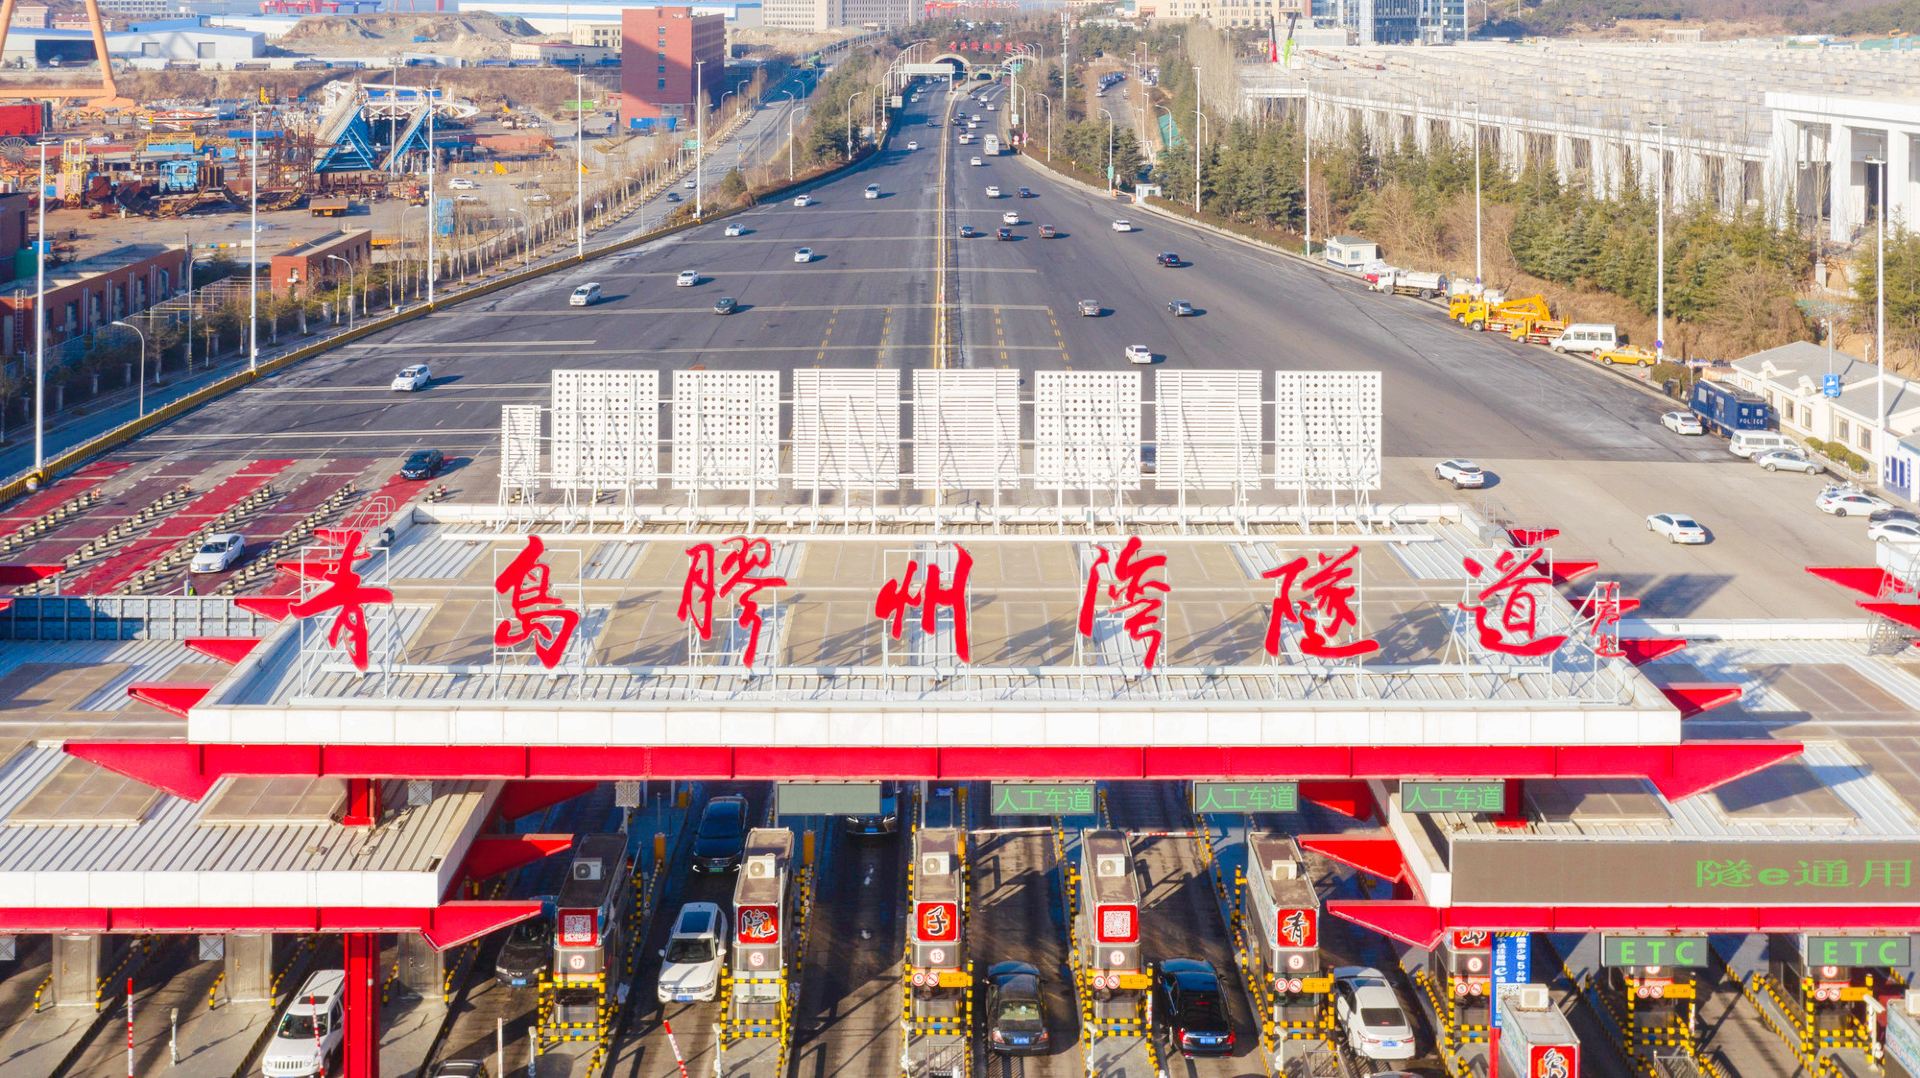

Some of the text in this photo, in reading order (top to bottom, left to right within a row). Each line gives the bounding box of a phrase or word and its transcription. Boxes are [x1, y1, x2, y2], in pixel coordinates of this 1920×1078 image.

[995, 788, 1092, 811] 人工车道
[1199, 787, 1294, 810] 人工车道
[1405, 786, 1500, 809] 人工车道
[742, 909, 776, 937] 院
[1282, 911, 1308, 946] 青
[1621, 941, 1694, 965] ETC
[1824, 941, 1897, 965] ETC
